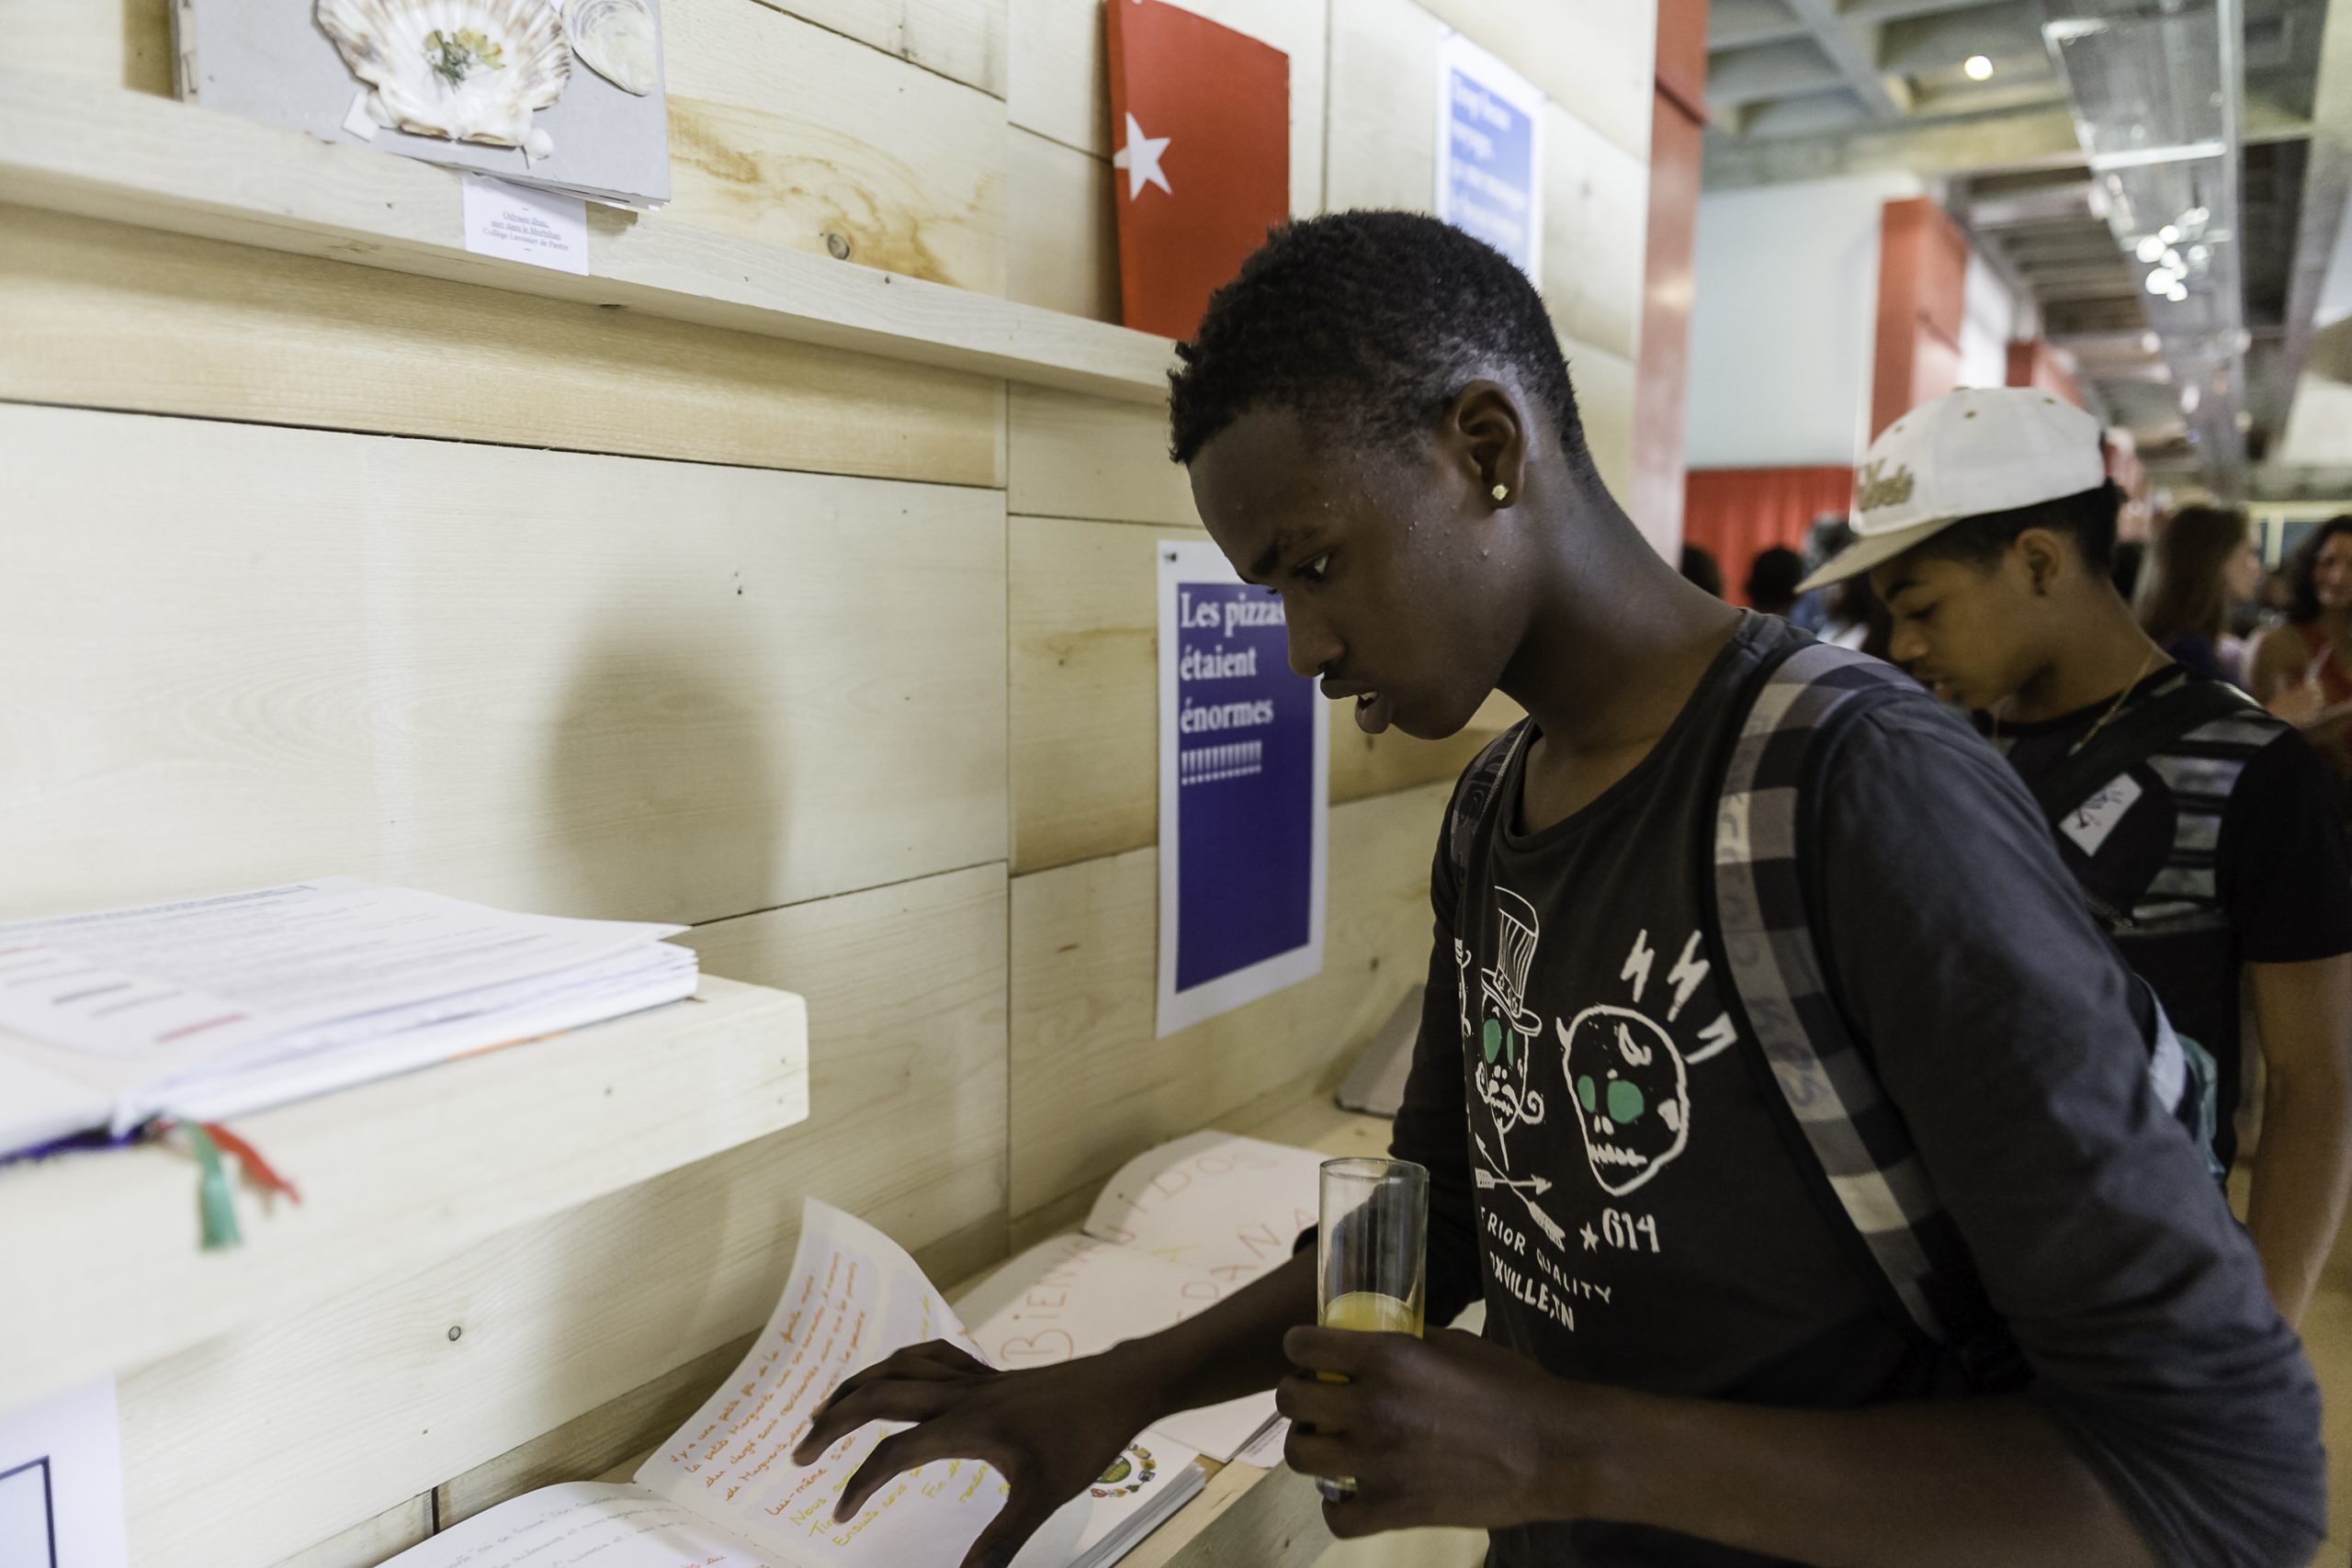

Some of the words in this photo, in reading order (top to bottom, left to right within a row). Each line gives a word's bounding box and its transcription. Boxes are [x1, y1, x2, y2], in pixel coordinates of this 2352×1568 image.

[1181, 592, 1220, 628] Les
[1181, 645, 1257, 682] étaient
[1181, 697, 1274, 734] énormes
[1602, 1207, 1661, 1253] 614
[789, 1496, 828, 1527] Nous
